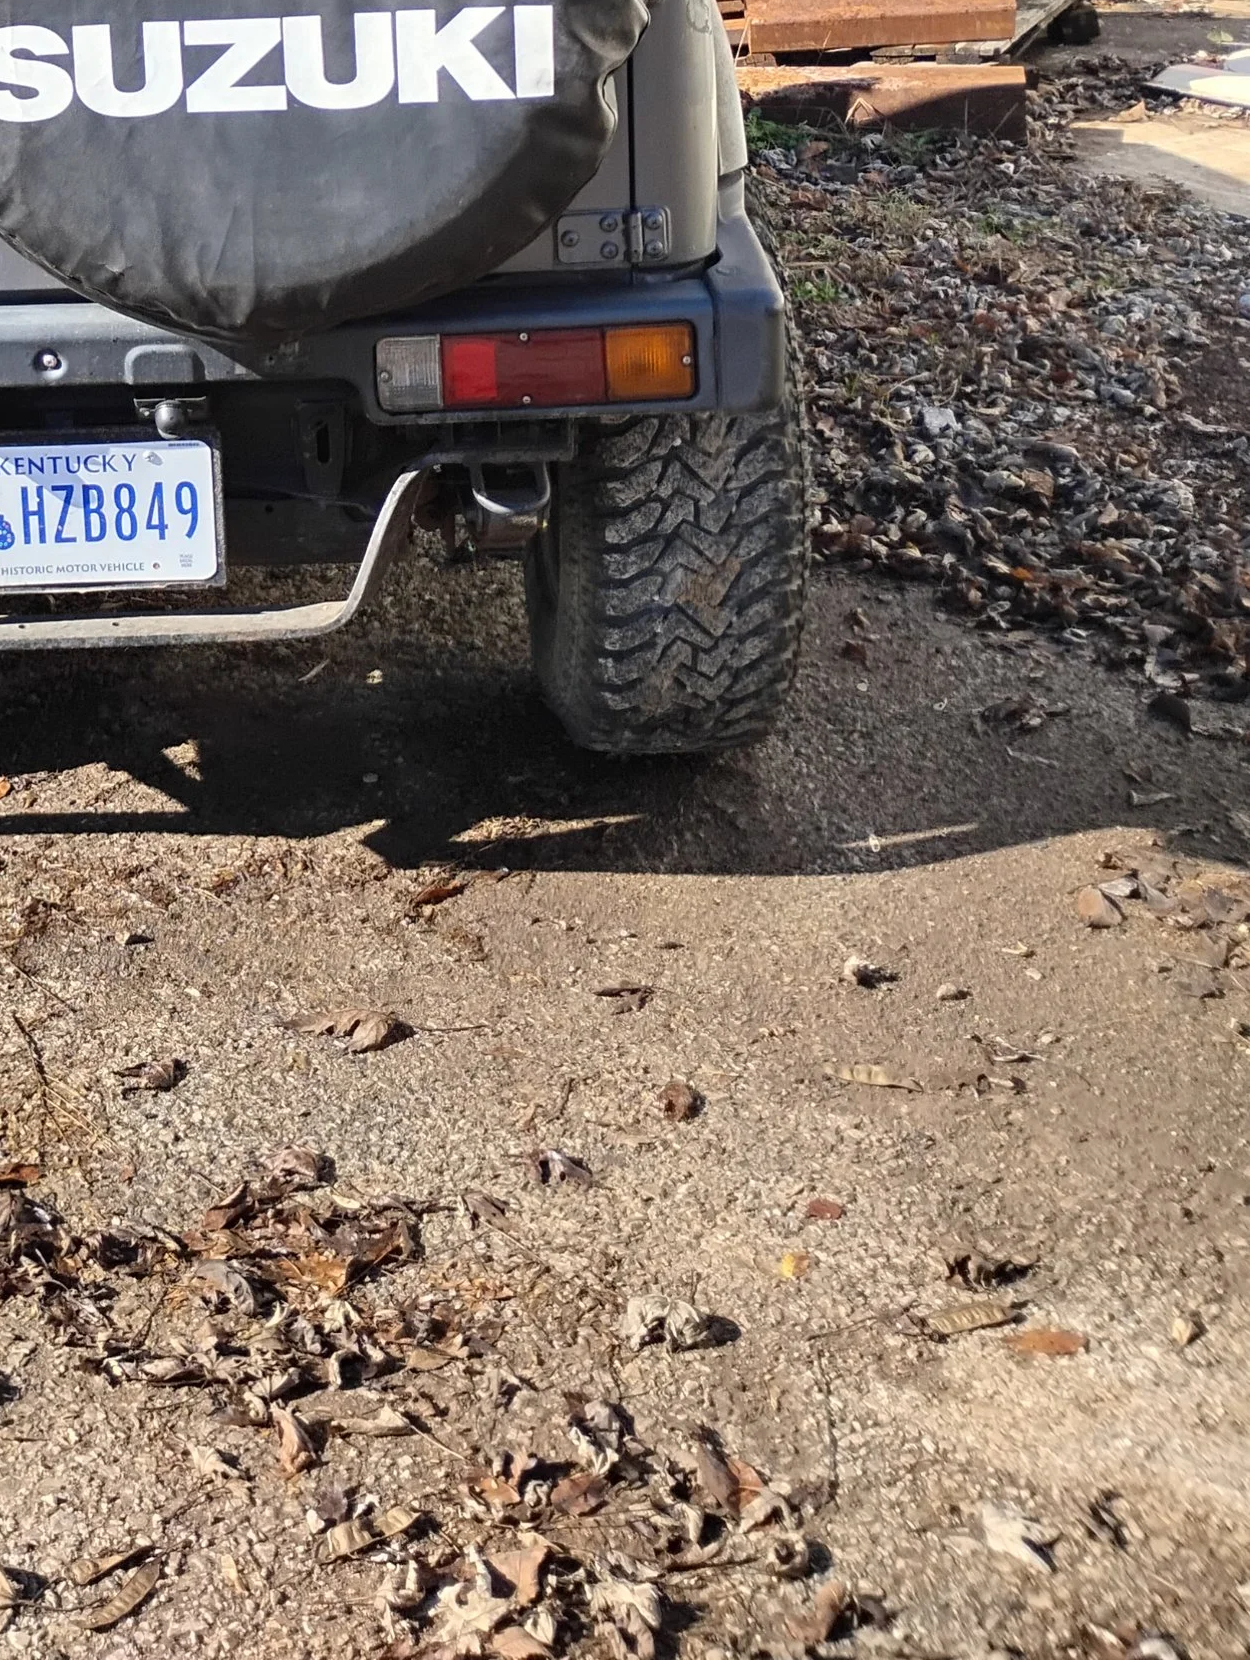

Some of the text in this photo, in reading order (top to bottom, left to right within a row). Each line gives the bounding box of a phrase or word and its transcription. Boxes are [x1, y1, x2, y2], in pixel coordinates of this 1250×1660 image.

[20, 481, 199, 545] HZB849
[1, 562, 145, 576] HISTORIC MOTOR VEHICLE
